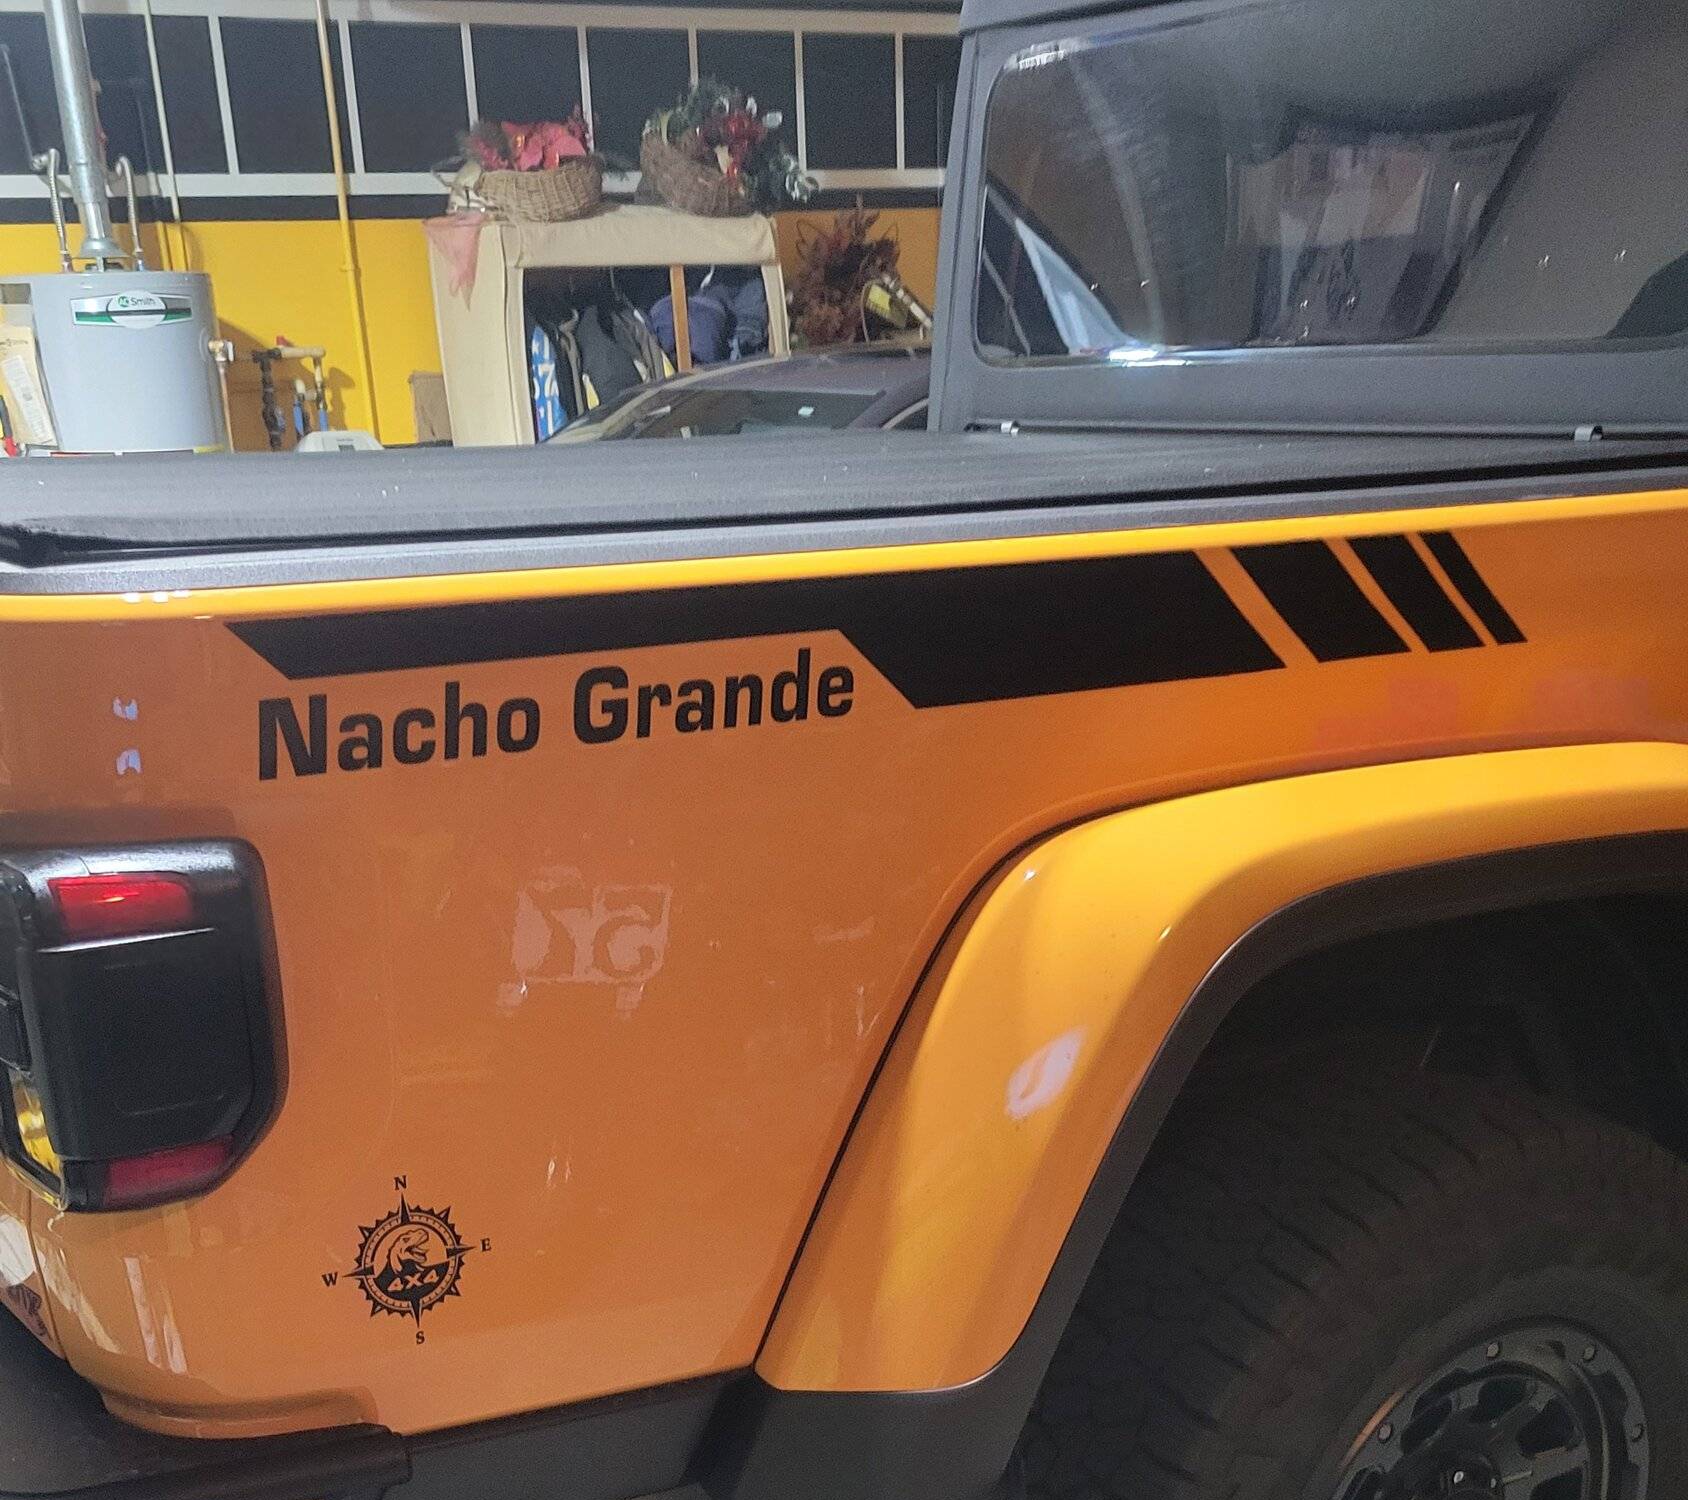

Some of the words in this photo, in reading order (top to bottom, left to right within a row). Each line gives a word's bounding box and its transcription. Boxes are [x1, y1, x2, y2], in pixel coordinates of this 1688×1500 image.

[258, 681, 541, 781] Nacho
[573, 647, 855, 745] Grande
[394, 1175, 407, 1190] N
[481, 1238, 492, 1252] E
[322, 1272, 339, 1288] W
[415, 1331, 425, 1345] S
